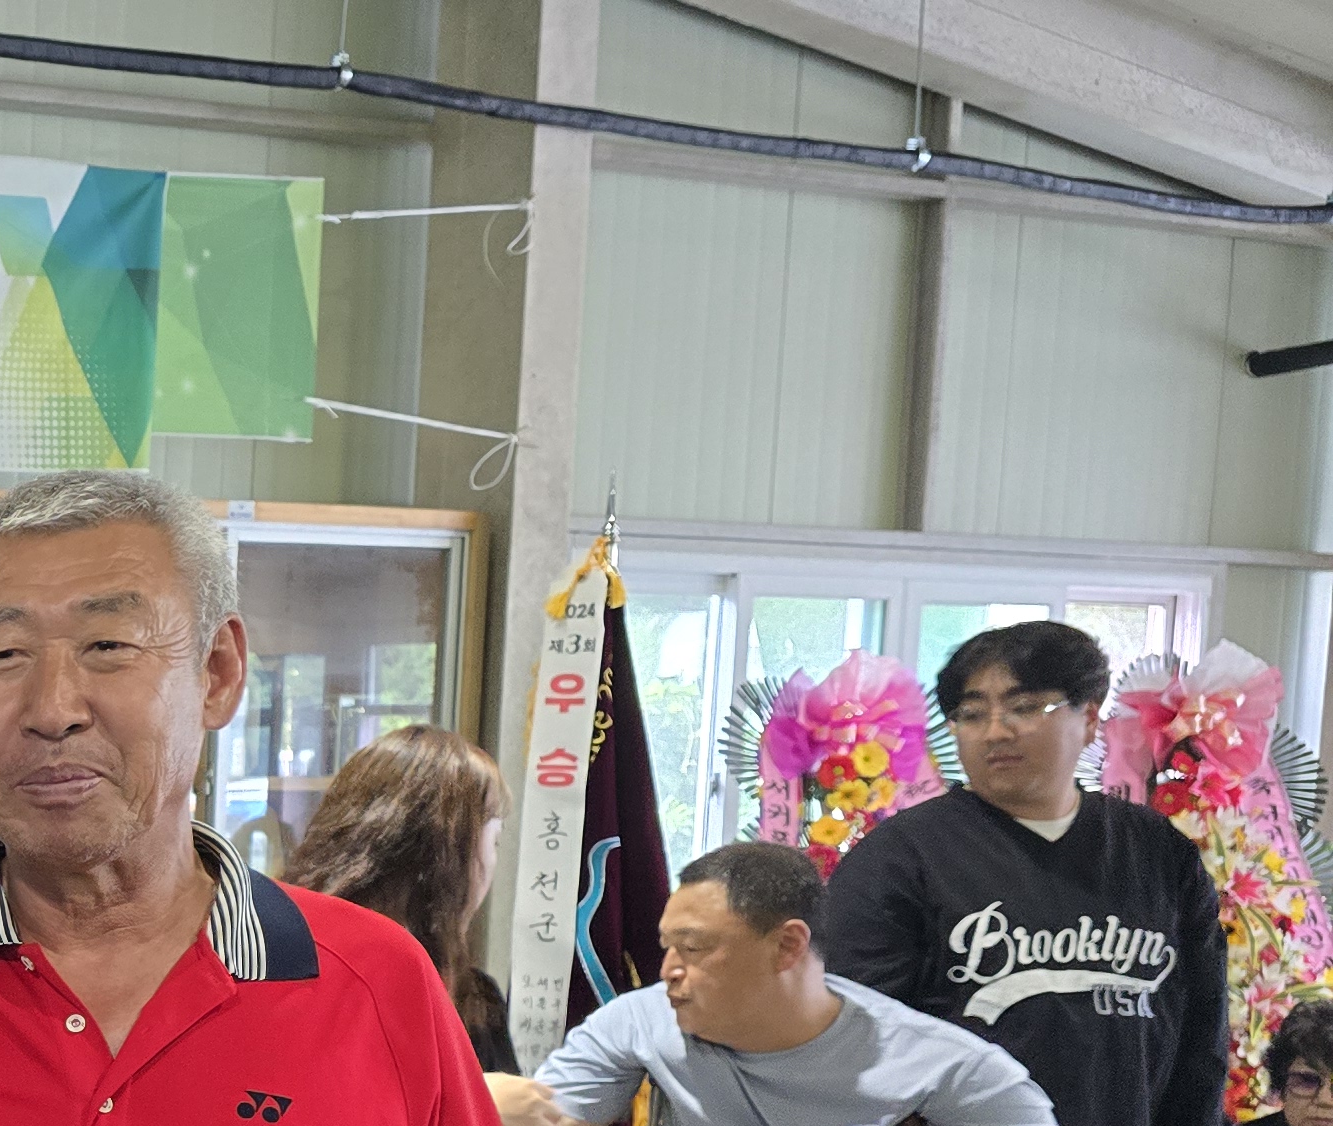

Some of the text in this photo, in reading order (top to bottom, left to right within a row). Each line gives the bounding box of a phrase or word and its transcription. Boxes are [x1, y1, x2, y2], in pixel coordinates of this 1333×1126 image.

[564, 602, 596, 619] 024
[947, 901, 1177, 985] Brooklyn
[1091, 983, 1157, 1019] USA
